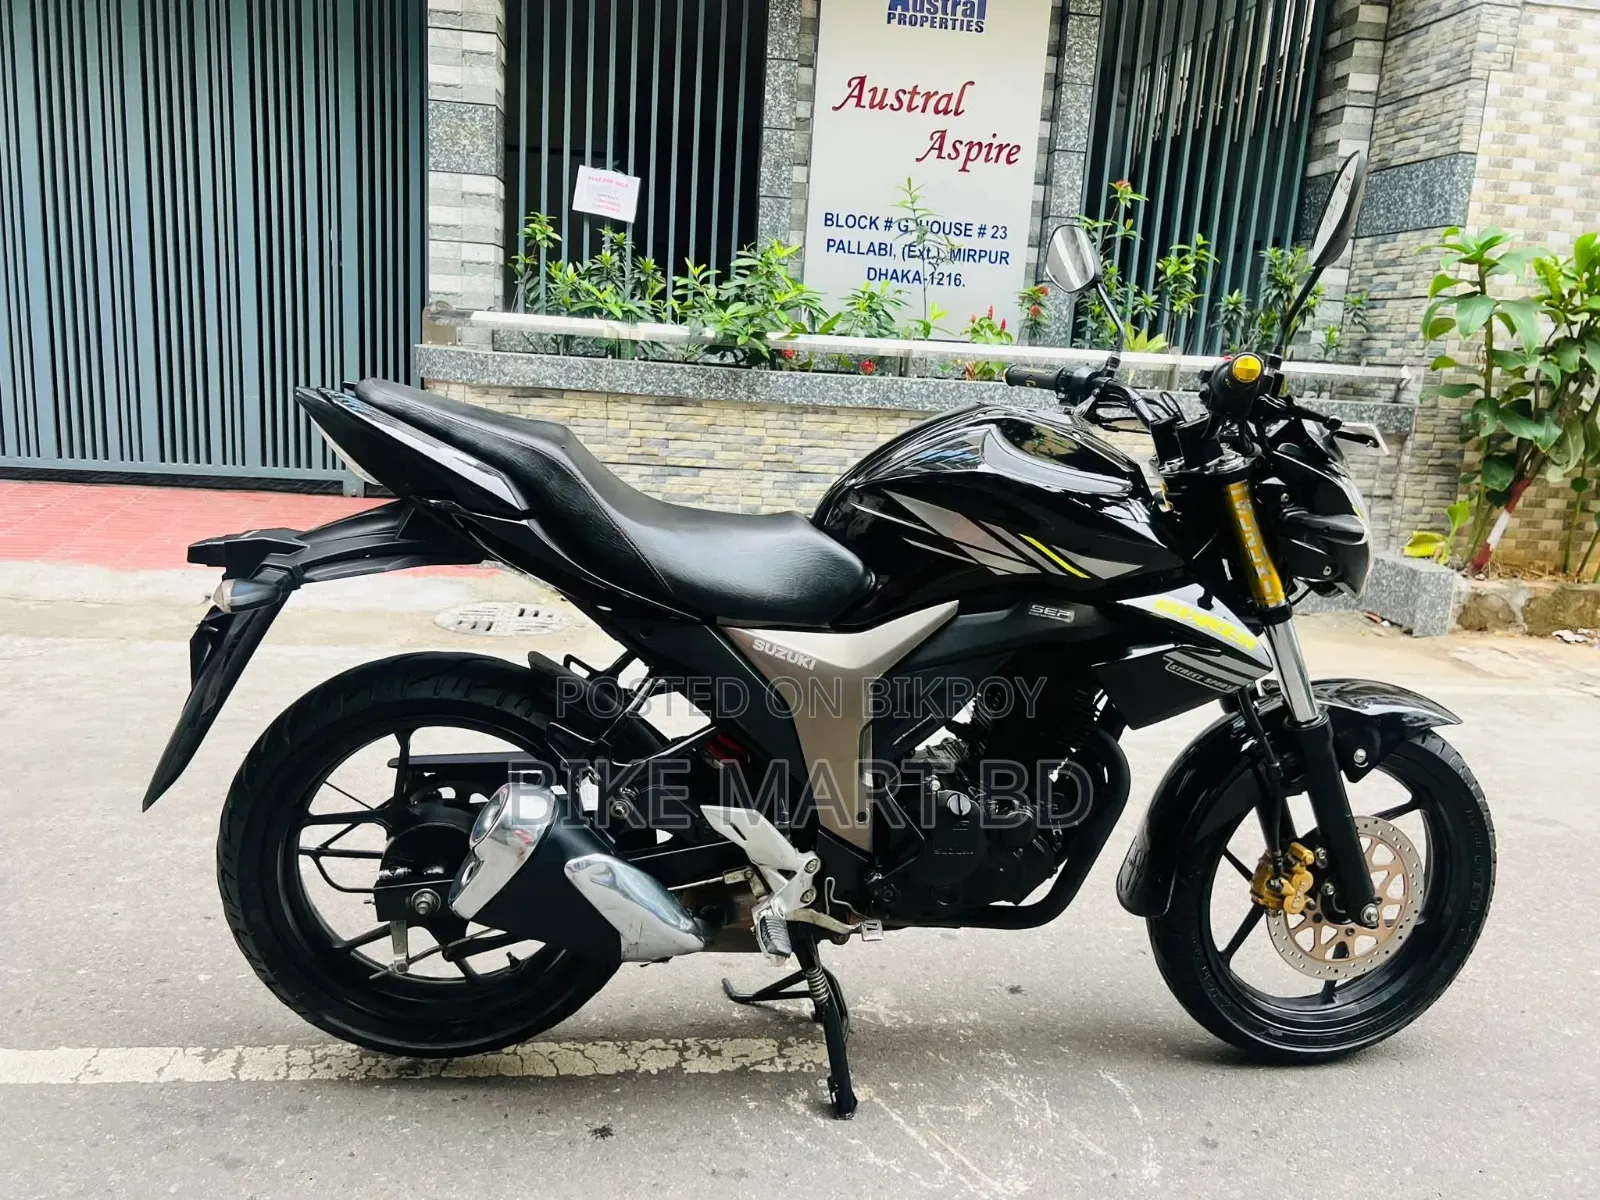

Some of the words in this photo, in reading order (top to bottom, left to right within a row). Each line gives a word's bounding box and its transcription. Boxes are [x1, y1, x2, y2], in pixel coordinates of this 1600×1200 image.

[886, 11, 985, 34] PROPERTIES
[831, 74, 976, 117] Austral
[915, 128, 1022, 173] Aspire
[823, 212, 880, 231] BLOCK
[884, 216, 894, 232] #
[977, 223, 987, 239] #
[990, 225, 1008, 240] 23
[825, 238, 897, 261] PALLABI,
[949, 247, 1011, 266] MIRPUR
[866, 266, 966, 288] DHAKA-1216.
[751, 638, 818, 671] SUZUKI
[1169, 663, 1205, 681] STREET
[1203, 677, 1235, 692] SPORT
